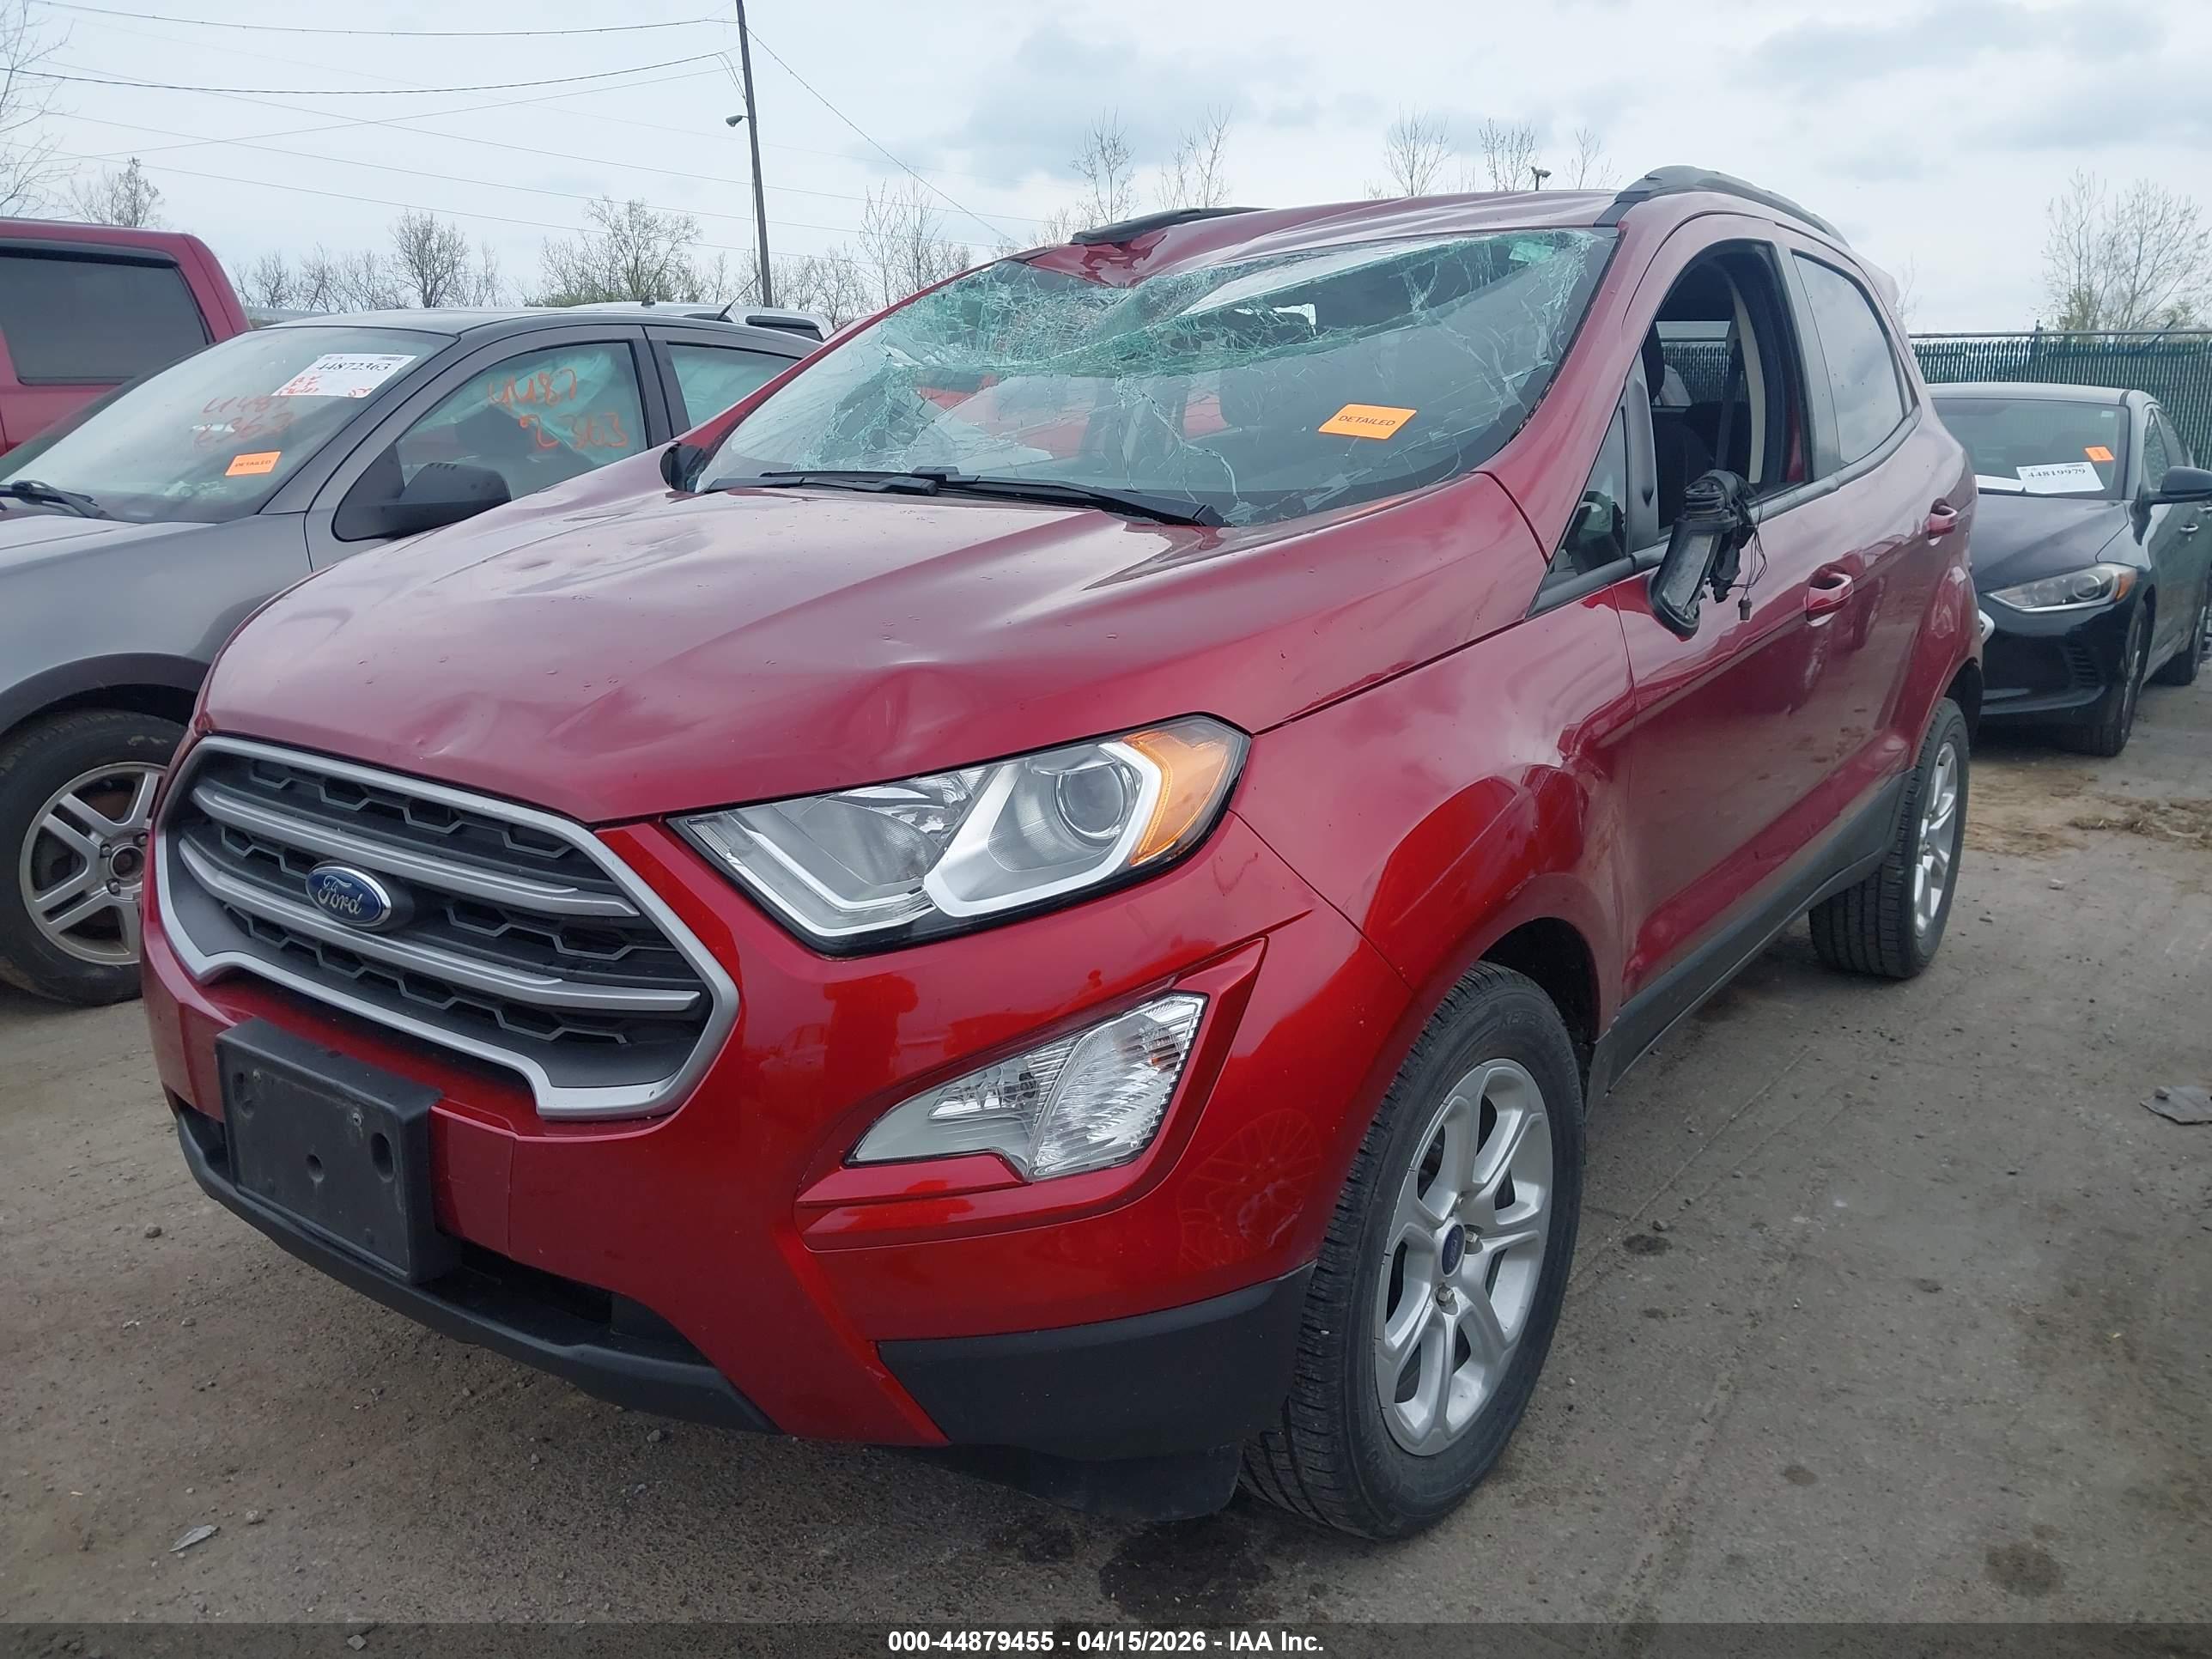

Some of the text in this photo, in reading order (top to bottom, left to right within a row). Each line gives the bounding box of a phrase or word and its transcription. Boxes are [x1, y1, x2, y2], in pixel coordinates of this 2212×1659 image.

[316, 362, 392, 371] 44872363
[1338, 415, 1396, 427] DETAILED
[234, 459, 271, 468] DETAILED
[2027, 469, 2086, 478] 44819979
[318, 875, 363, 915] Ford
